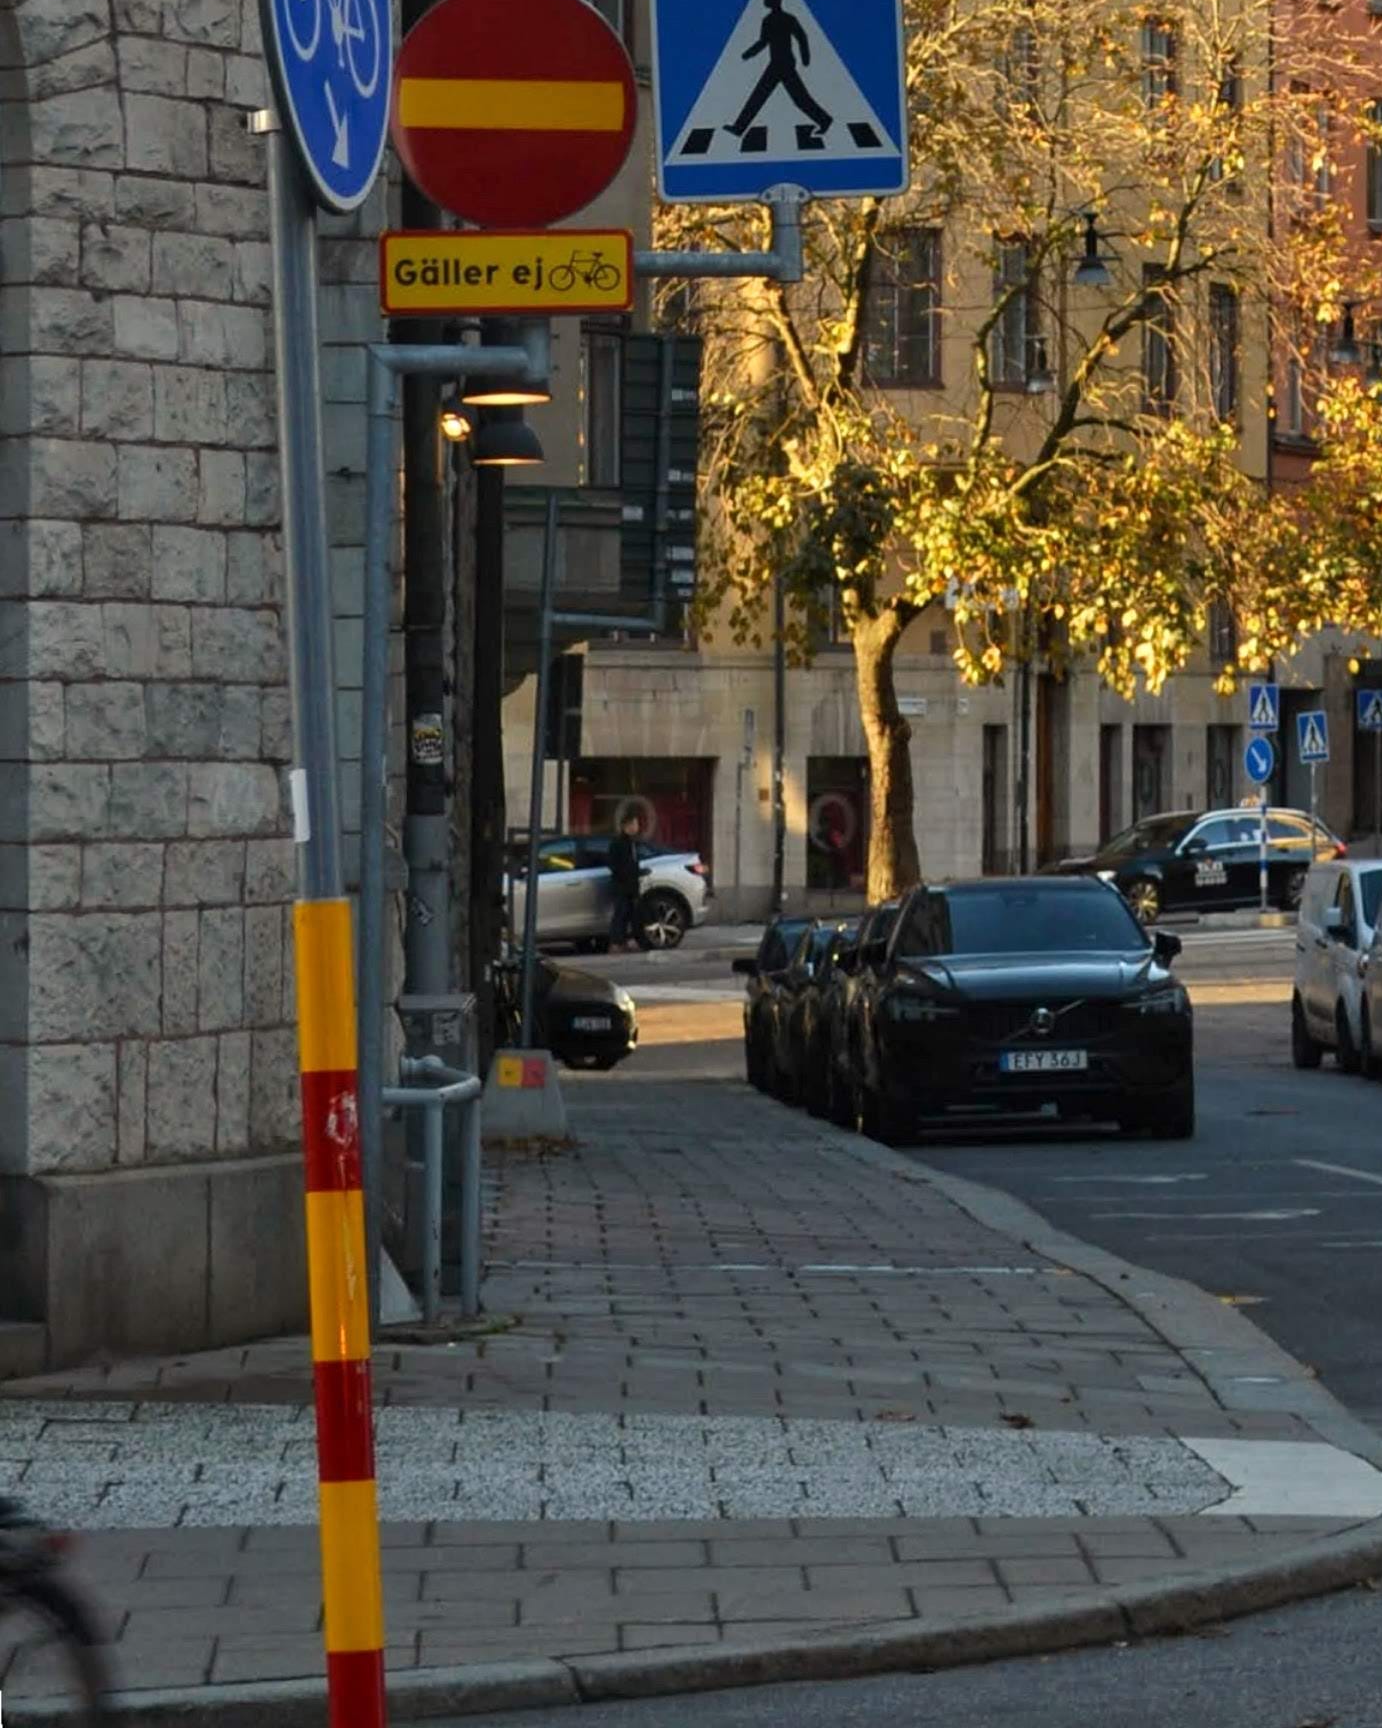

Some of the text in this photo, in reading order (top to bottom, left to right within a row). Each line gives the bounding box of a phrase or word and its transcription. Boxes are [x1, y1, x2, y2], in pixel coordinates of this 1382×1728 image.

[394, 256, 543, 291] Gäller ej
[1013, 1051, 1081, 1070] EFY 36J
